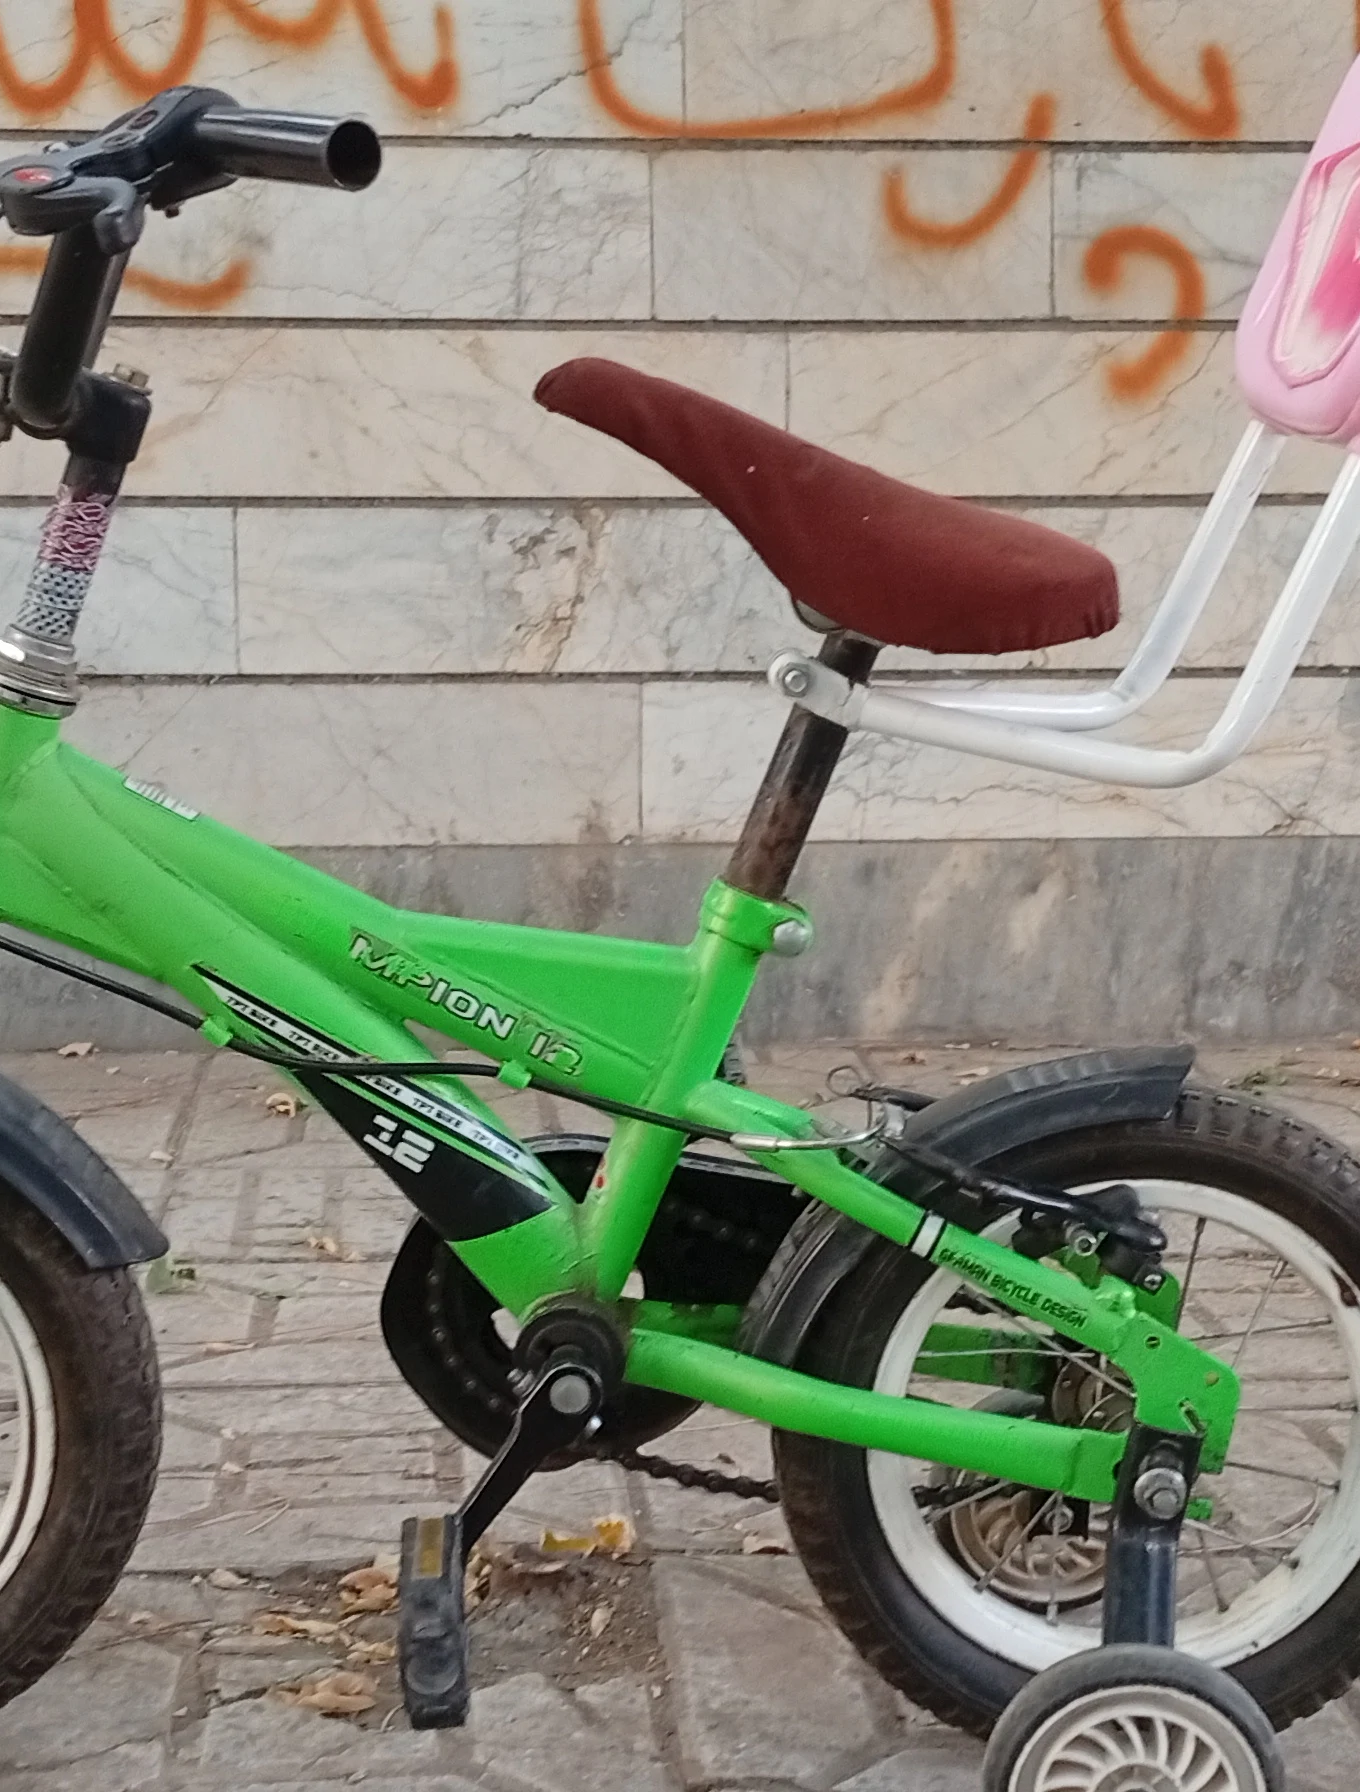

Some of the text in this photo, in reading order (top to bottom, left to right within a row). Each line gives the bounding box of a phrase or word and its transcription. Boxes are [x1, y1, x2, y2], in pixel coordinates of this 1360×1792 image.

[363, 1114, 436, 1173] 12
[990, 1274, 1043, 1307] BICYCLE
[1040, 1298, 1088, 1328] DESIGN
